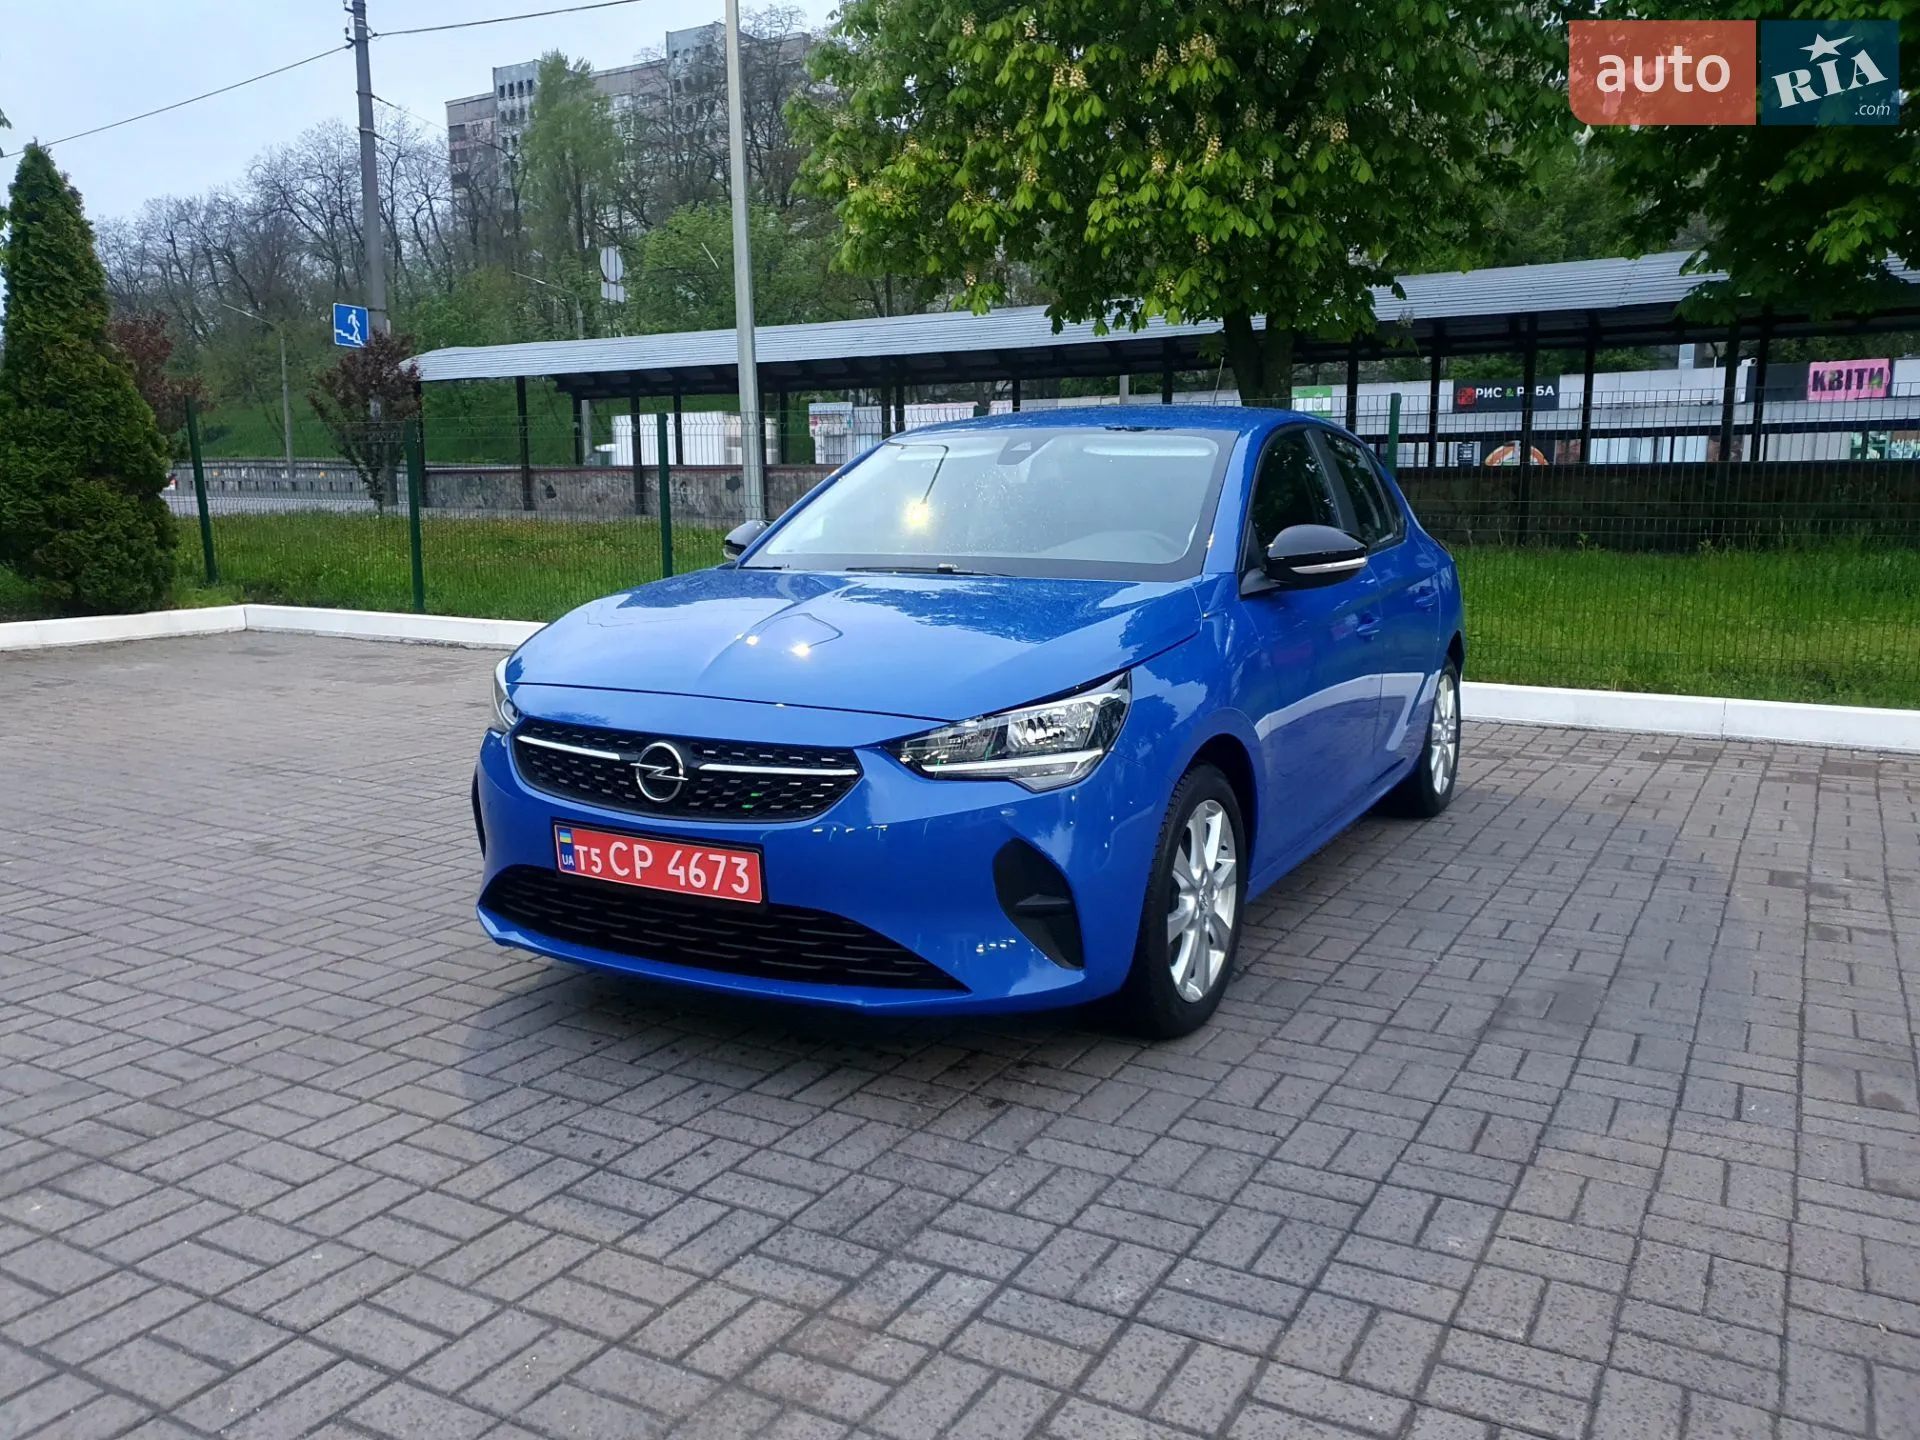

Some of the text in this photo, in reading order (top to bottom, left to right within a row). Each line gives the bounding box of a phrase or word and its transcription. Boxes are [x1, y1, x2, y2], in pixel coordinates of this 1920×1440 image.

[1812, 367, 1884, 391] КВІТИ
[1476, 387, 1502, 398] РИС
[1516, 385, 1555, 397] РБА
[562, 853, 574, 866] UA
[667, 850, 750, 894] 4673
